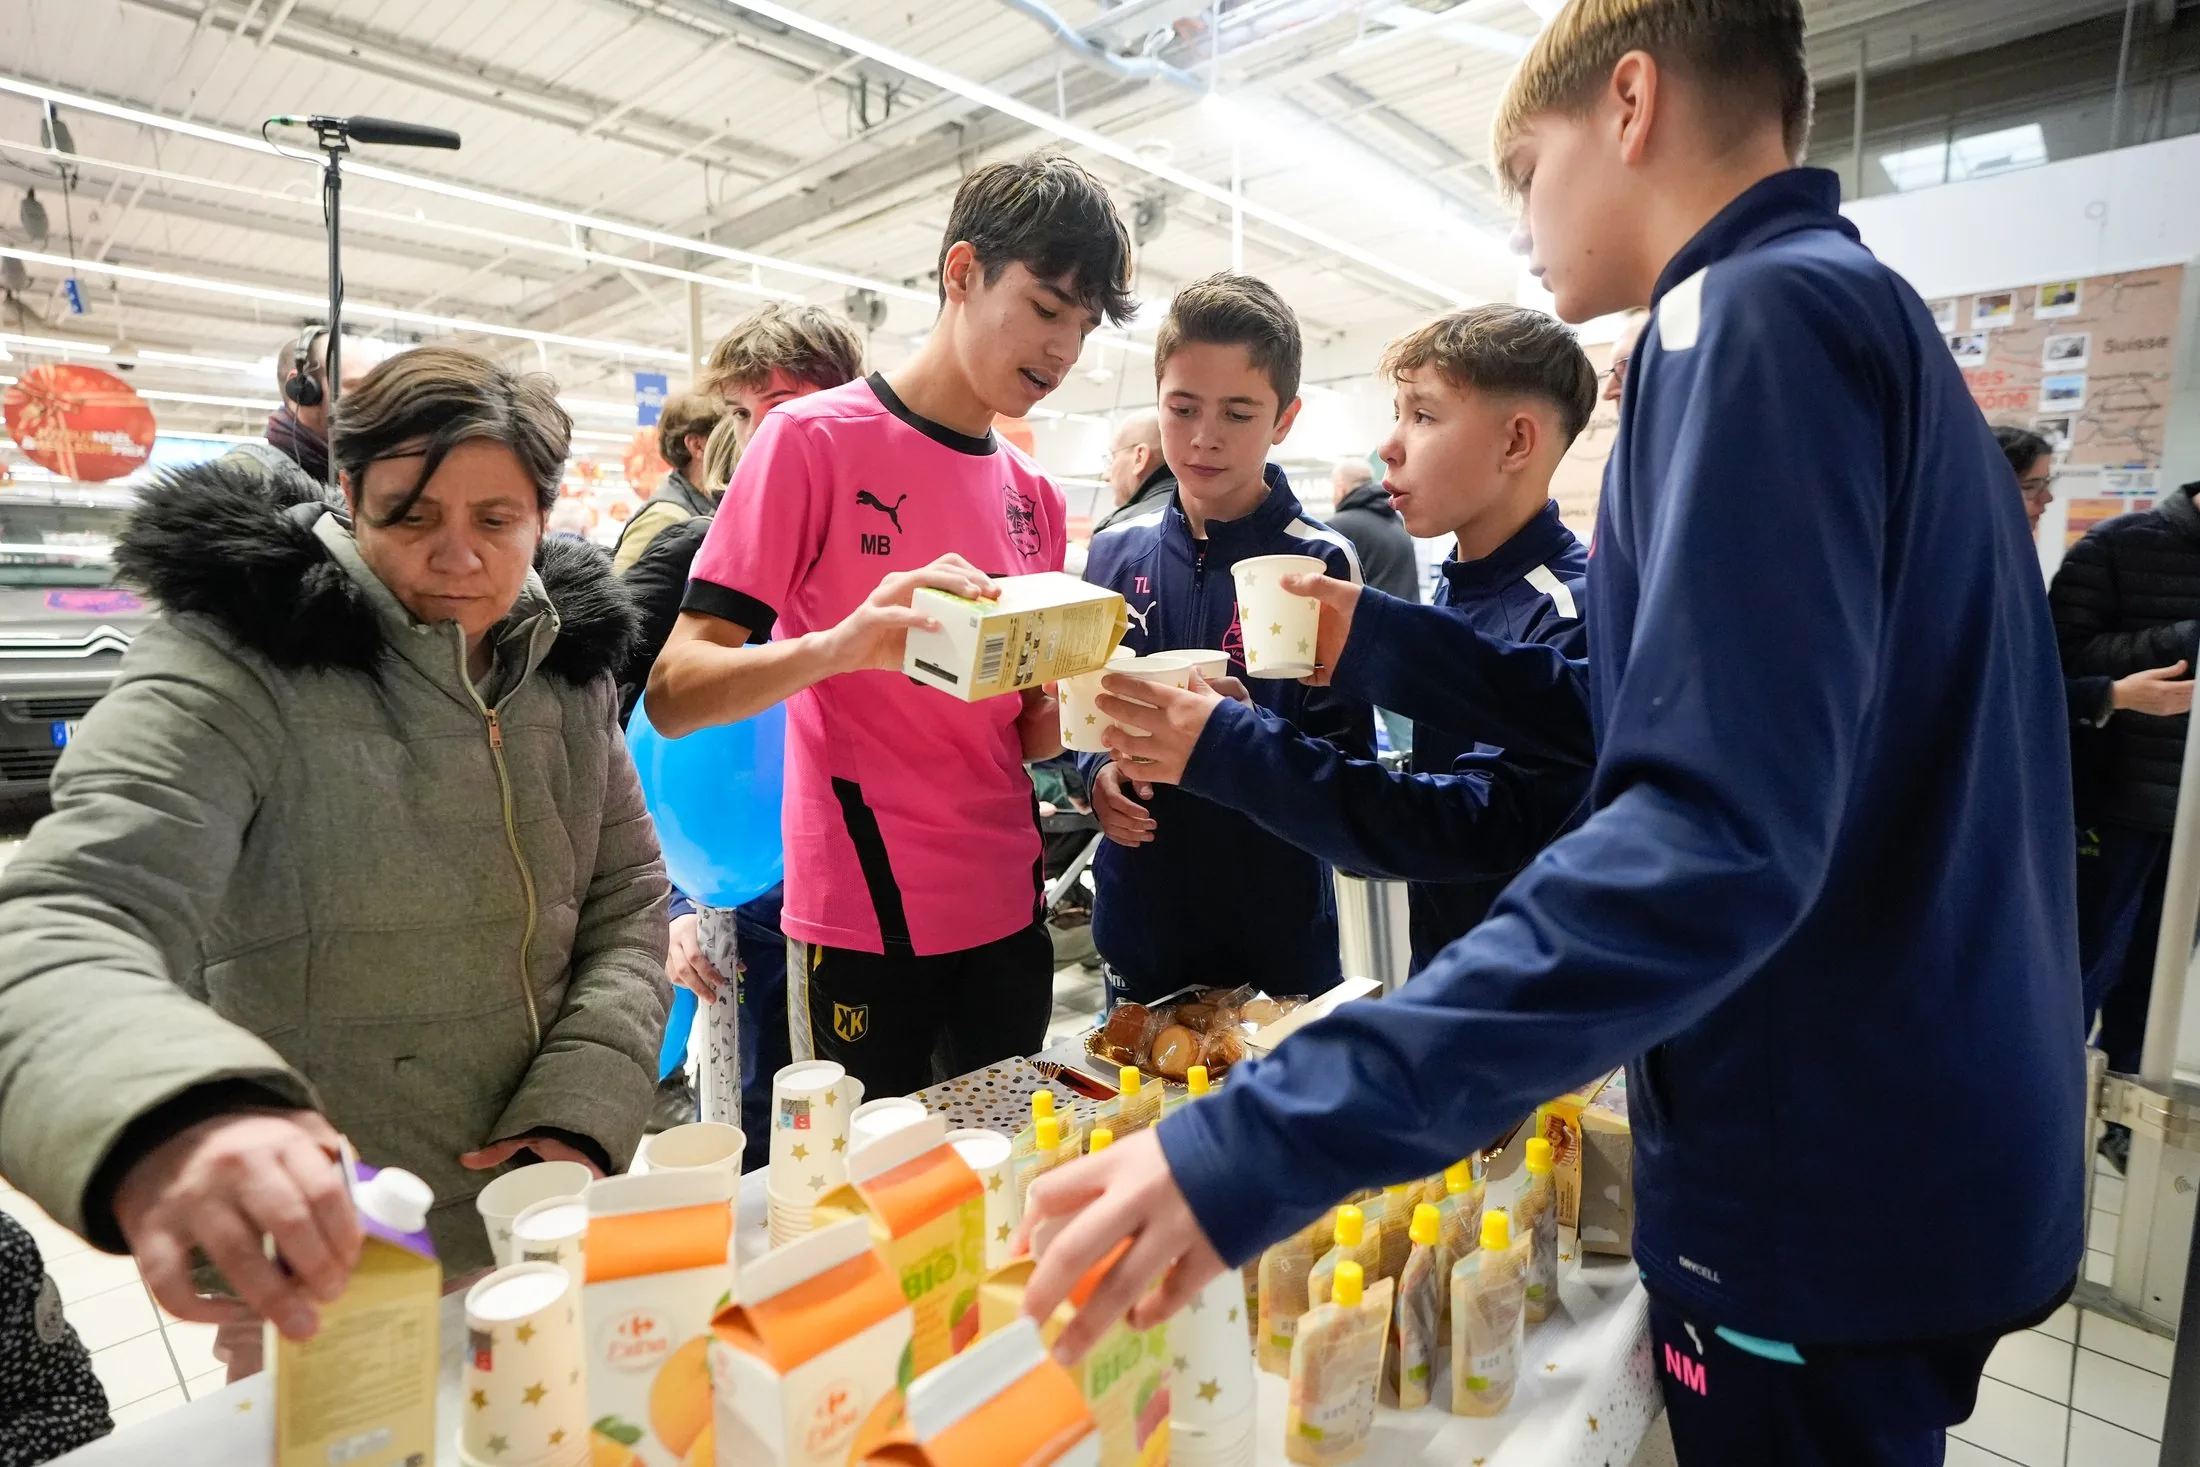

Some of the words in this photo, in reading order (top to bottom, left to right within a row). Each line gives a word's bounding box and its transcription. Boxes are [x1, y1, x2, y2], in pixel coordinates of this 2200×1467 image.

[2103, 335, 2169, 354] Suisse
[860, 533, 891, 555] MB
[1134, 576, 1151, 594] TL
[902, 1252, 957, 1300] BIO
[1679, 1255, 1721, 1284] DRYCELL
[1664, 1342, 1707, 1396] NM
